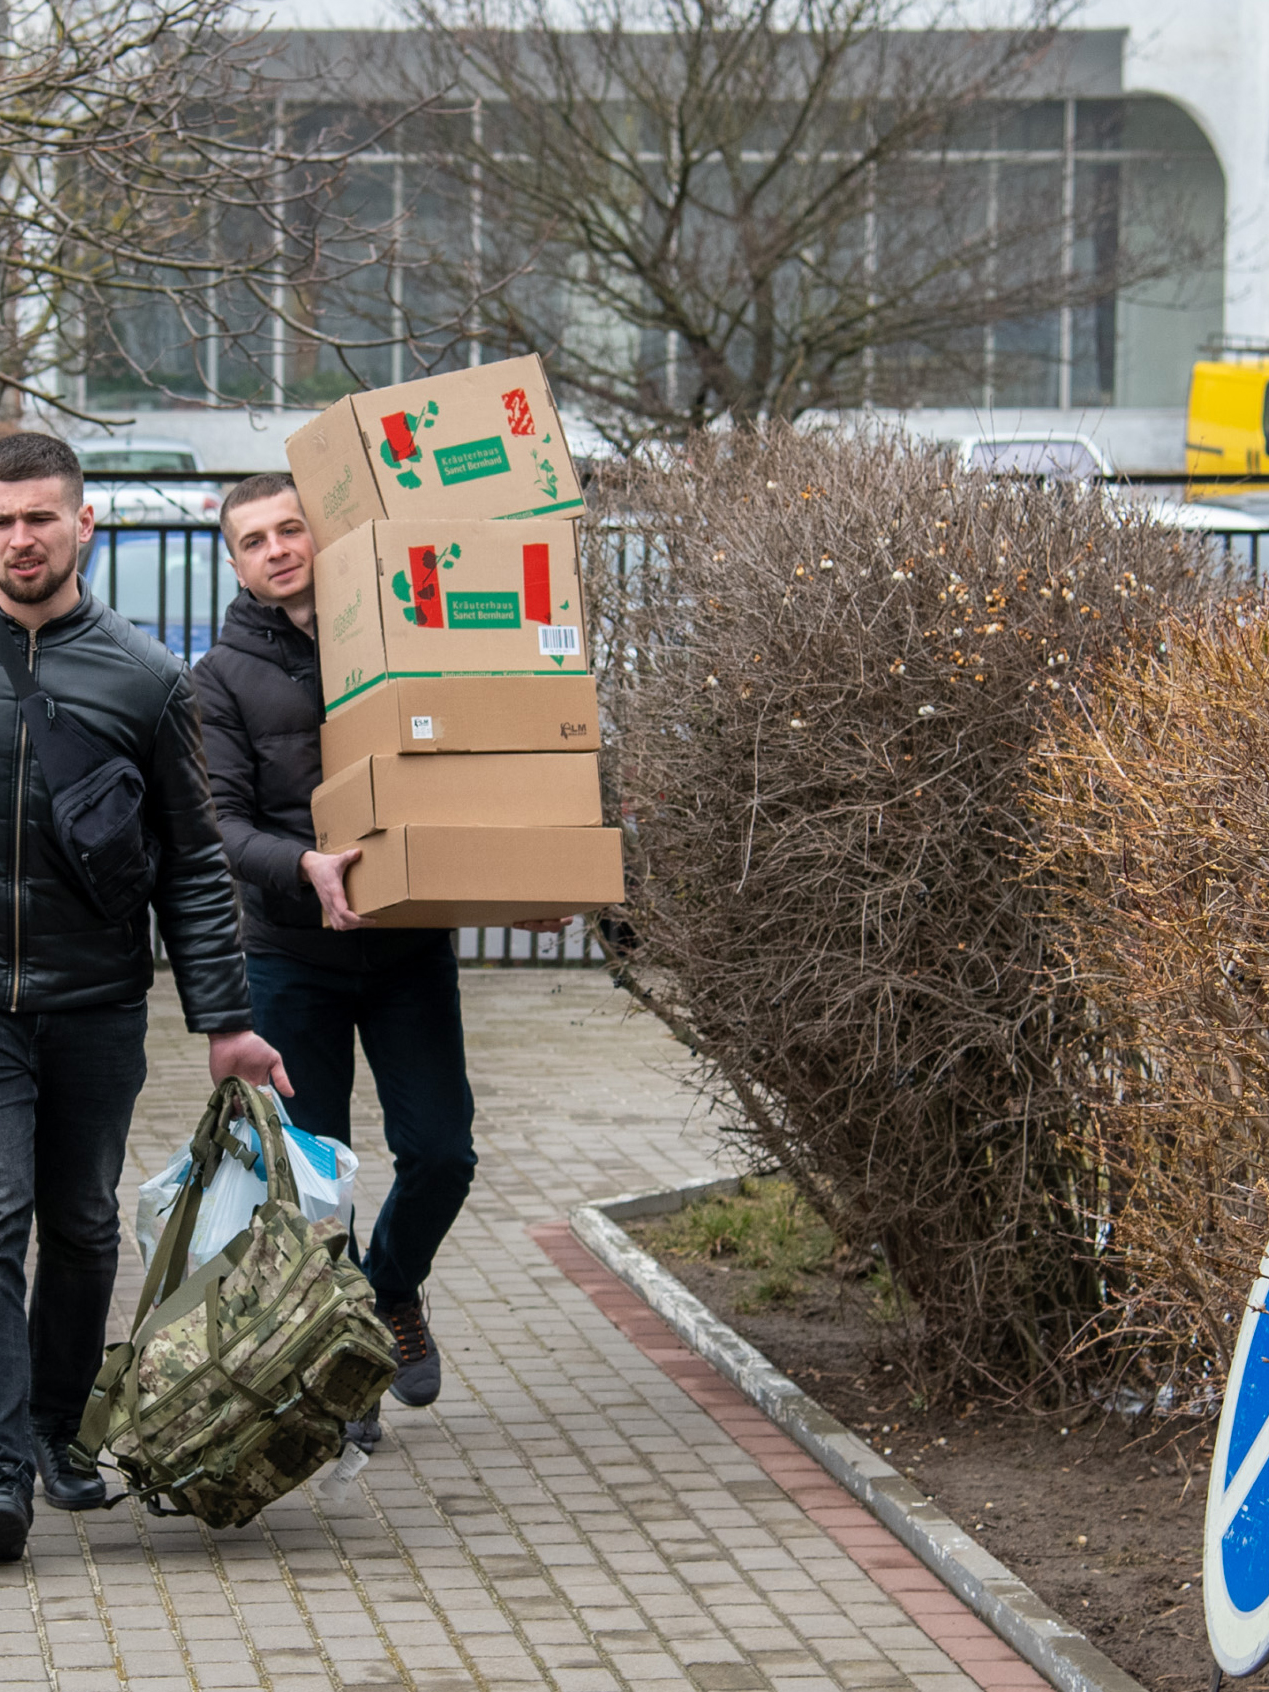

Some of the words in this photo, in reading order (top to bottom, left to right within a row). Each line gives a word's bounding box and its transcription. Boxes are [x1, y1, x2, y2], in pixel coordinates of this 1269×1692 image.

[441, 447, 499, 466] Kräuterhaus
[444, 463, 467, 476] Sanct
[467, 455, 502, 471] Bernhard
[452, 600, 513, 610] Kräuterhaus
[453, 610, 476, 620] Sanct
[477, 610, 514, 620] Bernhard
